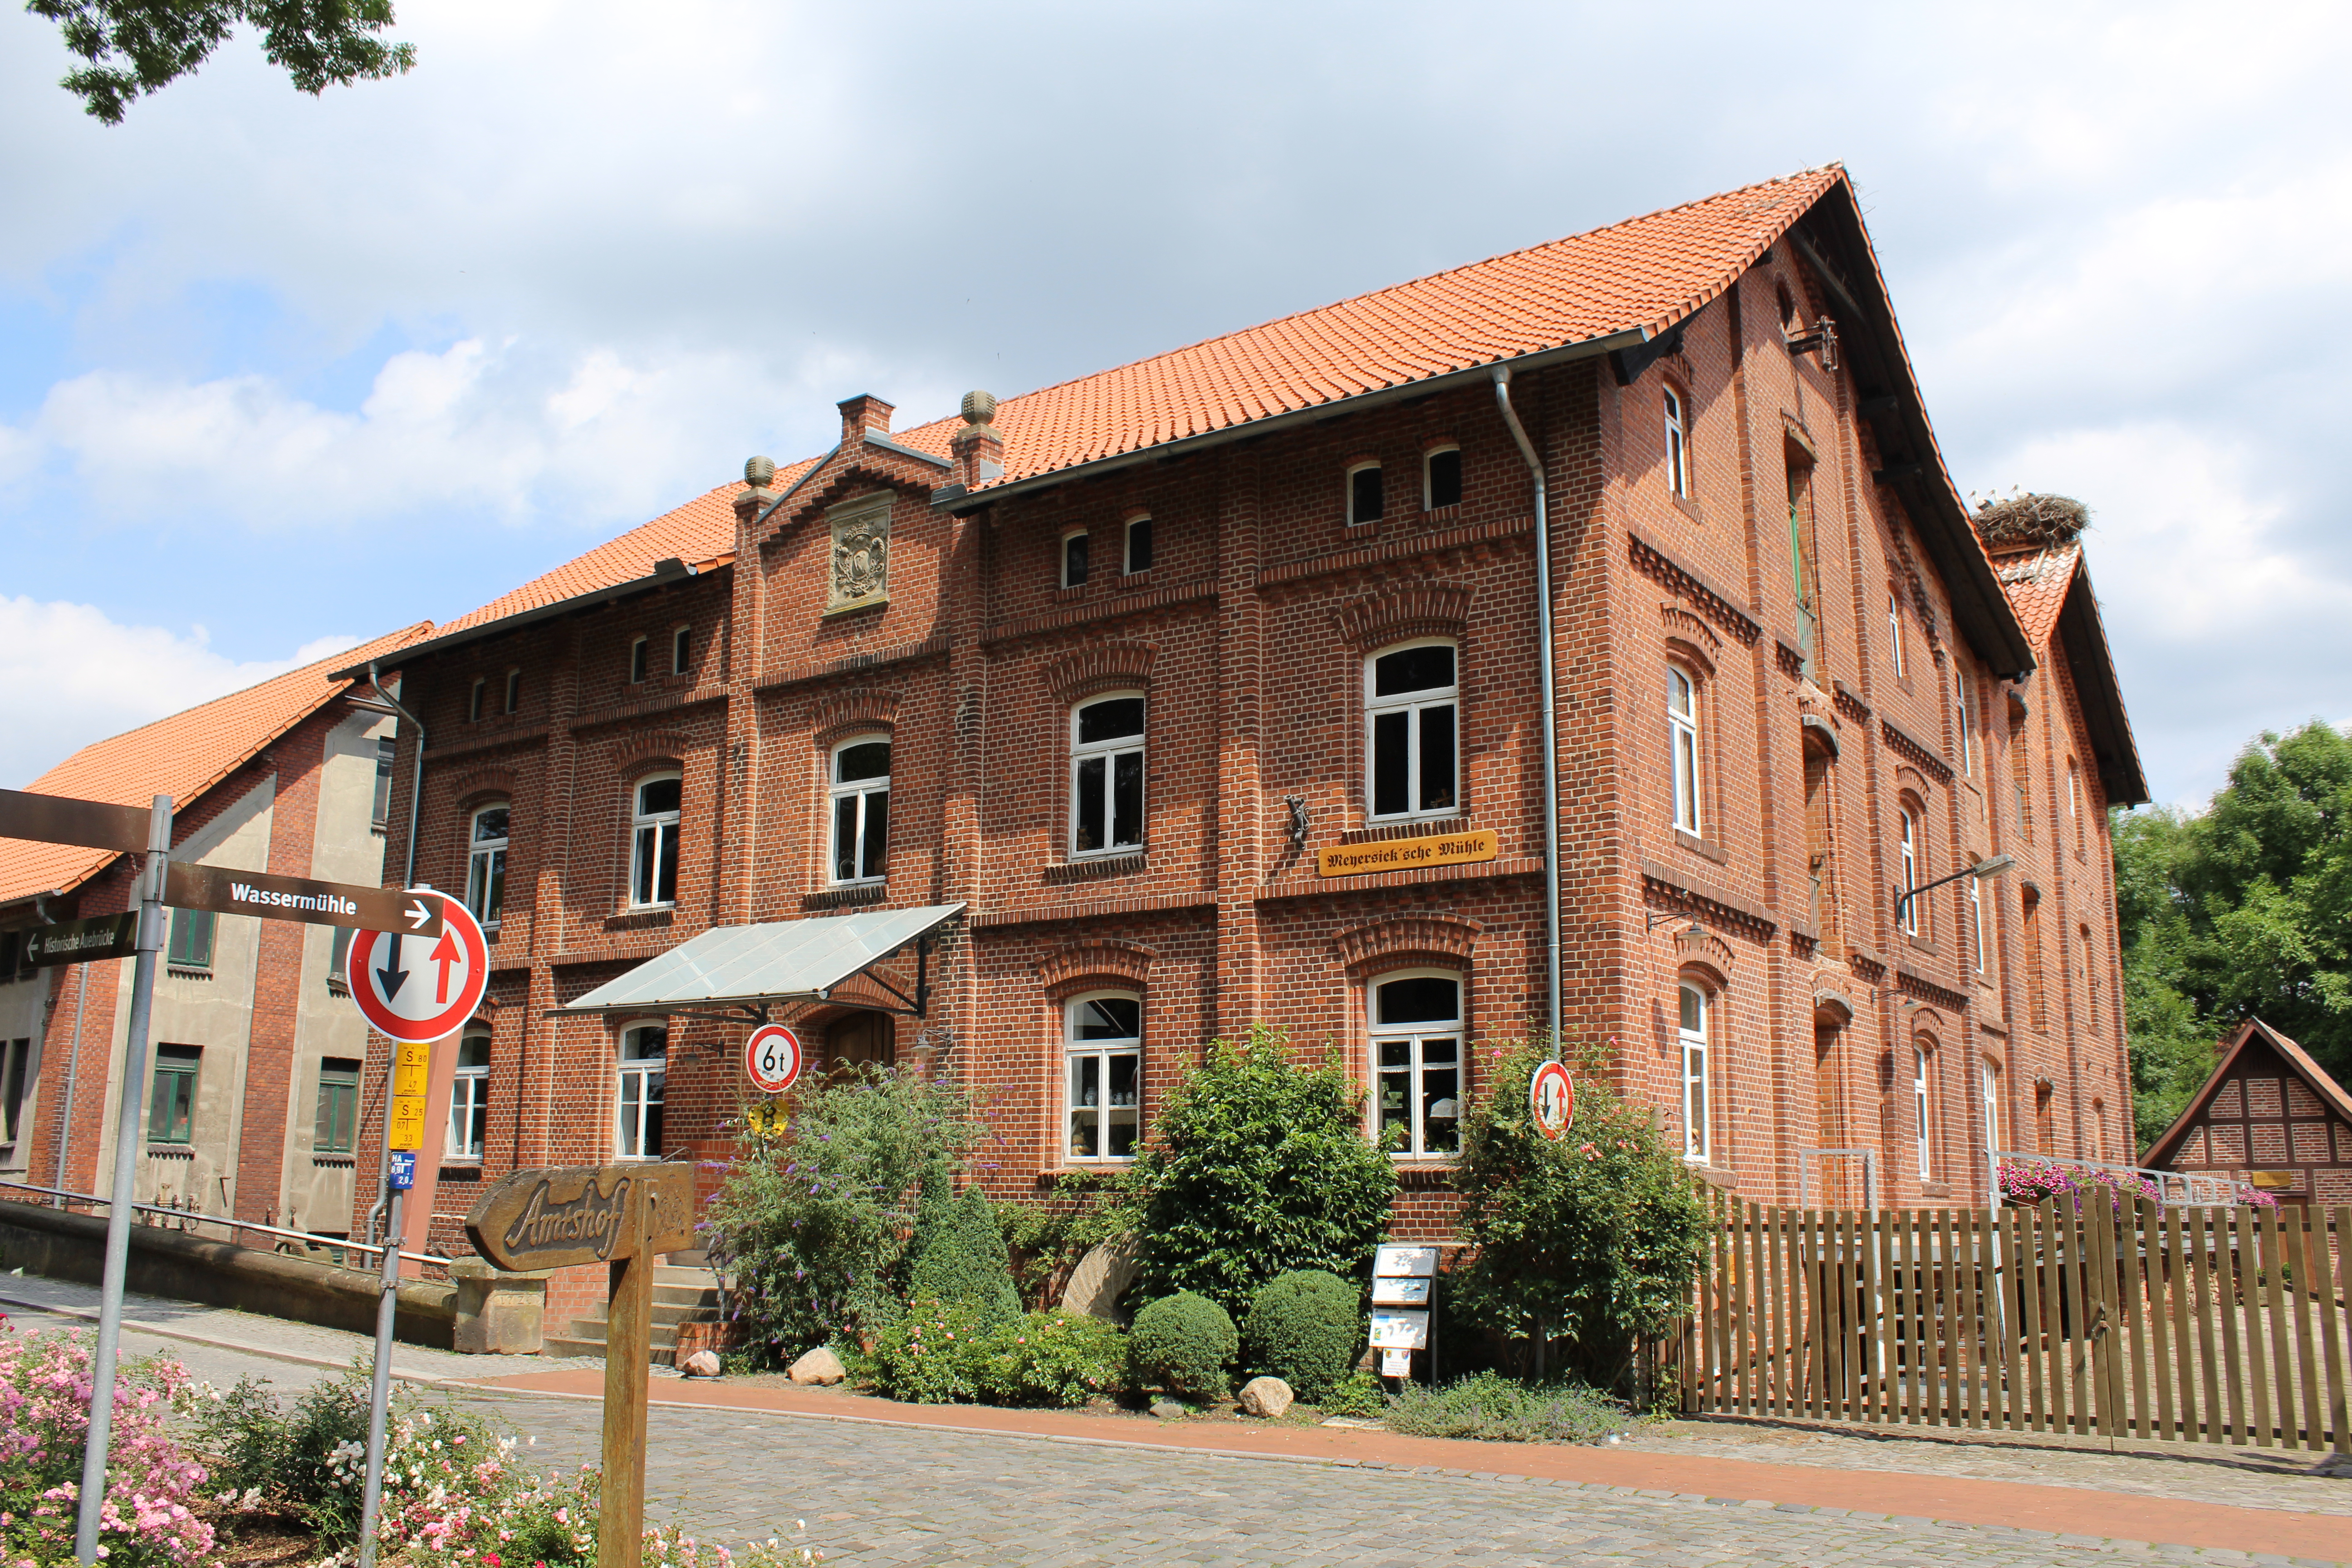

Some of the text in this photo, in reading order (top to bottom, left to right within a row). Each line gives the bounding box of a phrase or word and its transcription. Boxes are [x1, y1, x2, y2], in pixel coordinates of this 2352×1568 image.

[1438, 839, 1485, 857] Mühle
[230, 882, 357, 915] Wassermühle
[44, 928, 114, 953] Historische Auebrücke
[406, 1051, 413, 1062] S
[402, 1104, 409, 1116] S
[392, 1154, 402, 1162] HA
[391, 1166, 401, 1175] 8,9
[399, 1176, 409, 1185] 2,0
[505, 1180, 630, 1258] Amtshof
